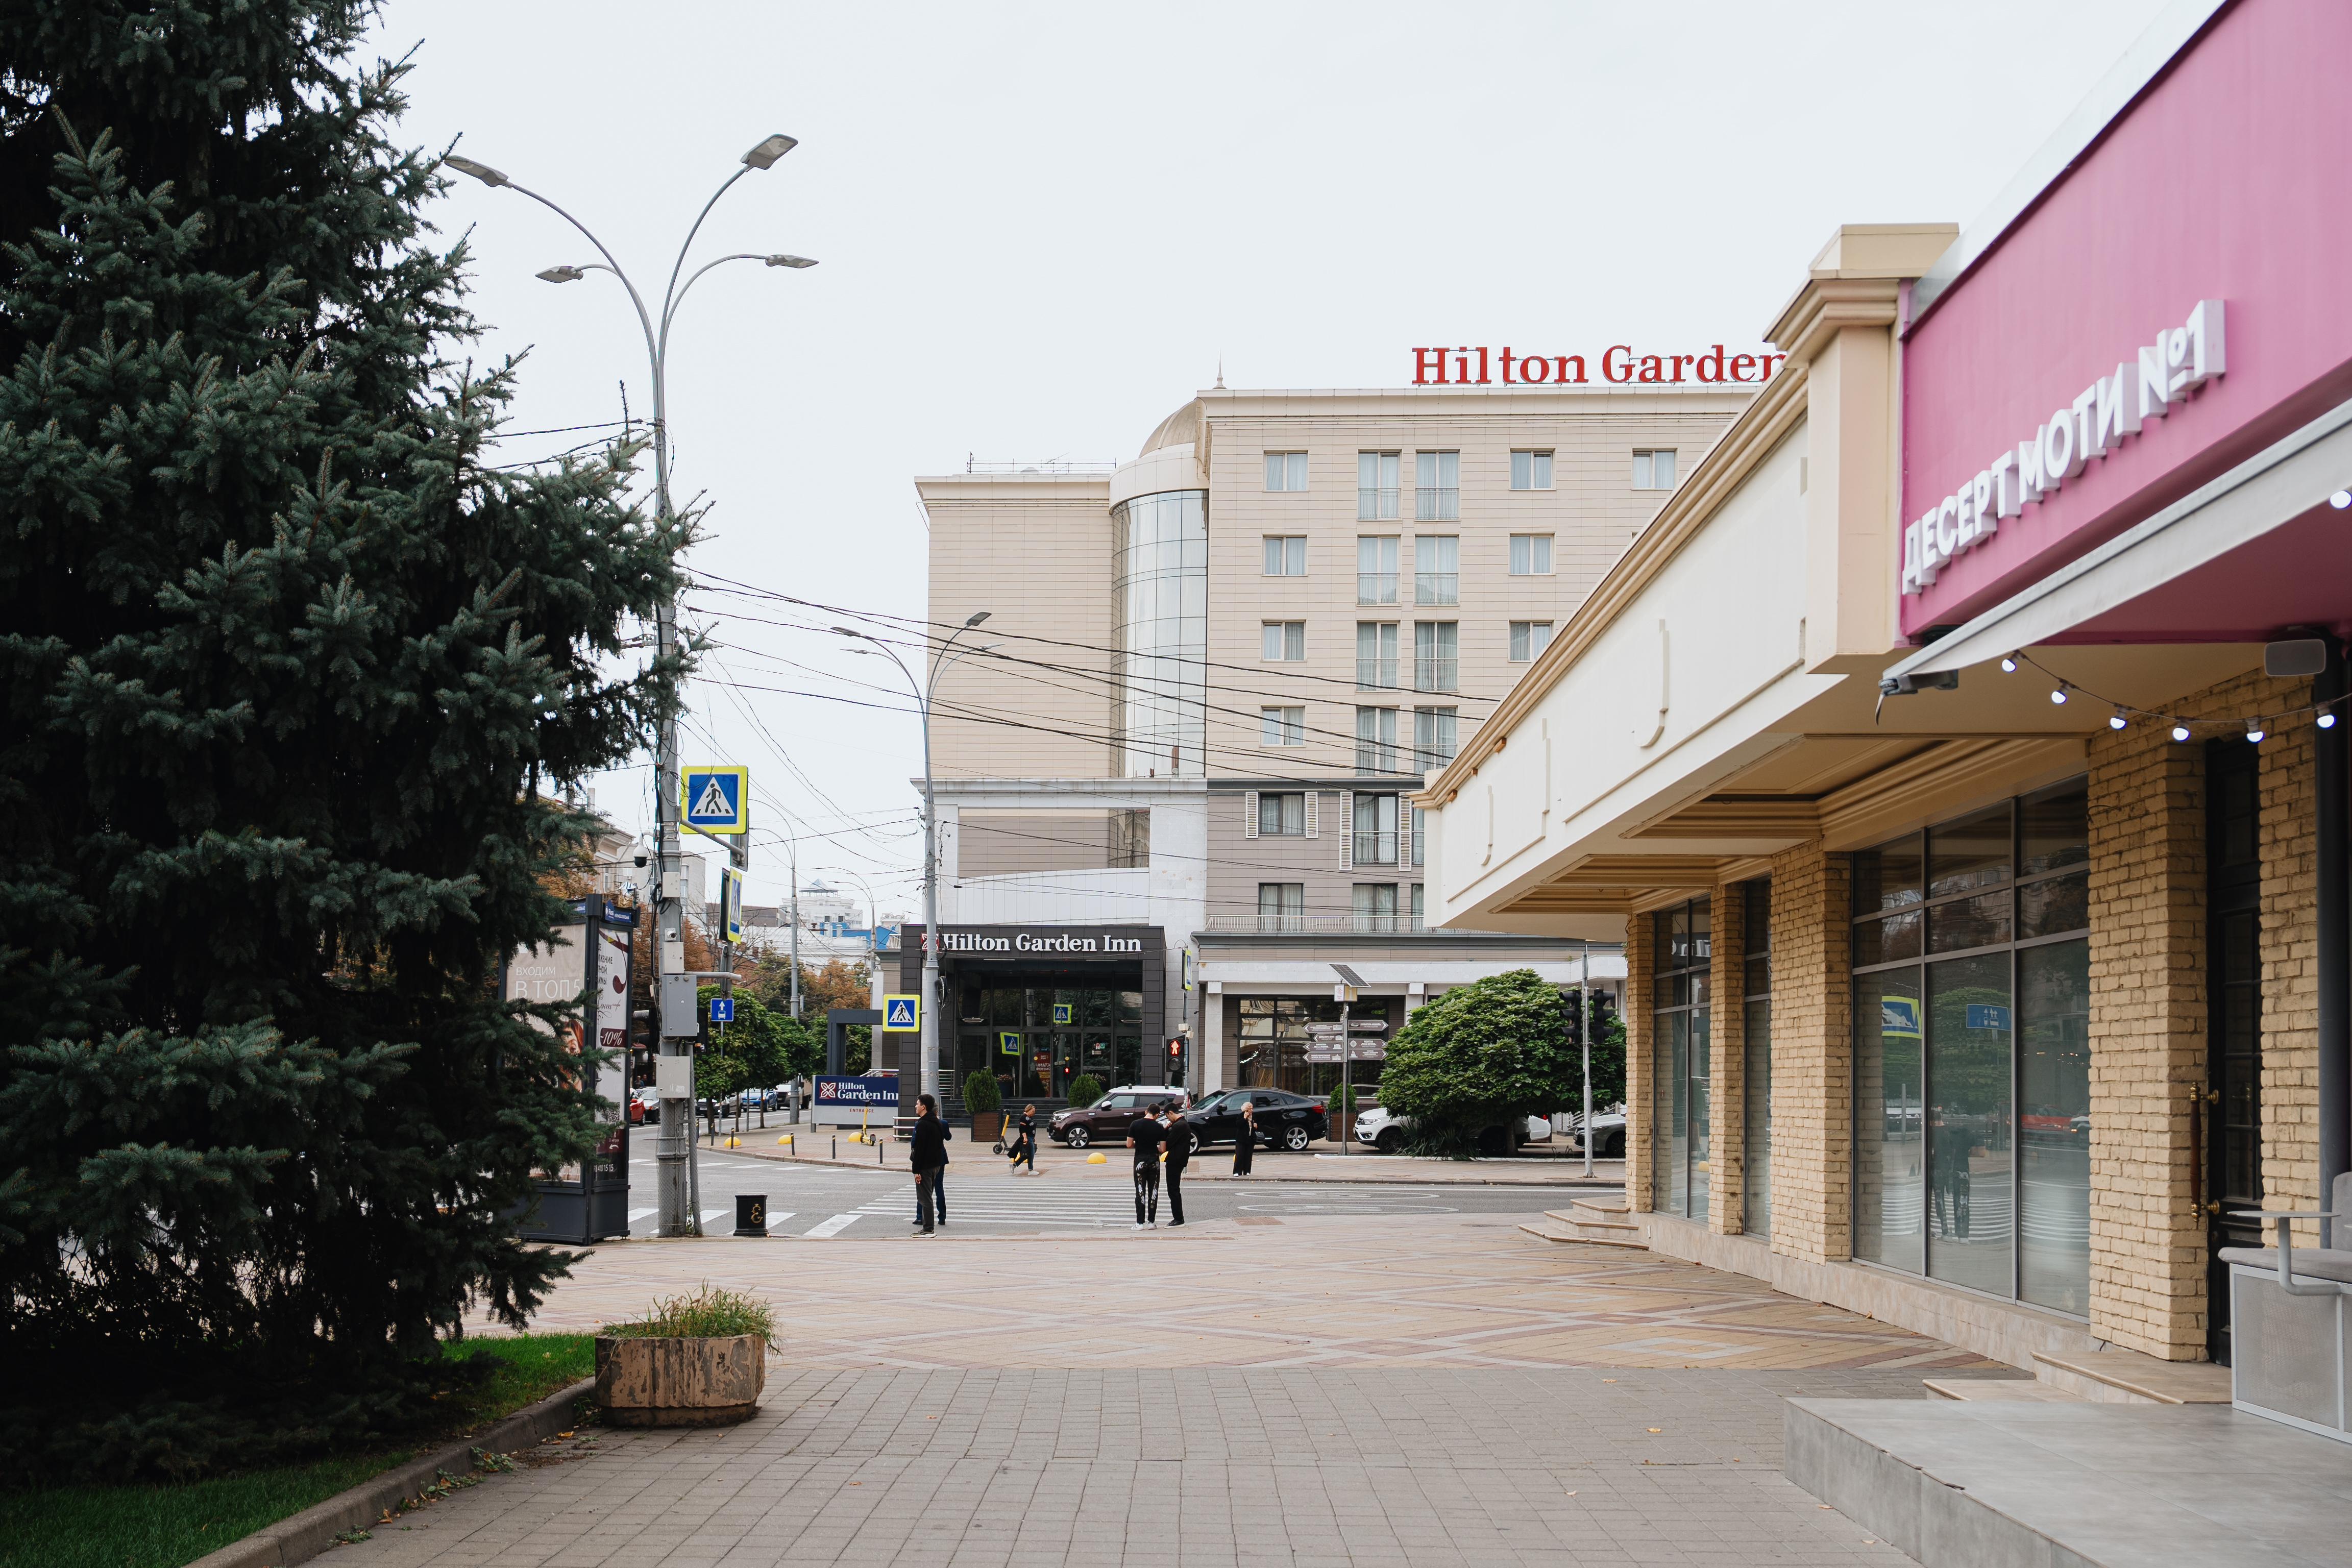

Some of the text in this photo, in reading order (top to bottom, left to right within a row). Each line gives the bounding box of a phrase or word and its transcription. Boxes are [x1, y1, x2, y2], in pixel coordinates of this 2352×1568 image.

[1412, 346, 1588, 385] Hilton
[1902, 450, 2021, 595] ДЕСЕРТ
[2019, 362, 2142, 504] МОТИ
[942, 933, 1142, 952] Hilton Garden Inn
[516, 967, 555, 977] ВХОДИМ
[516, 979, 580, 998] В ТОП 5
[600, 1030, 623, 1046] -10%
[838, 1089, 881, 1100] Garden
